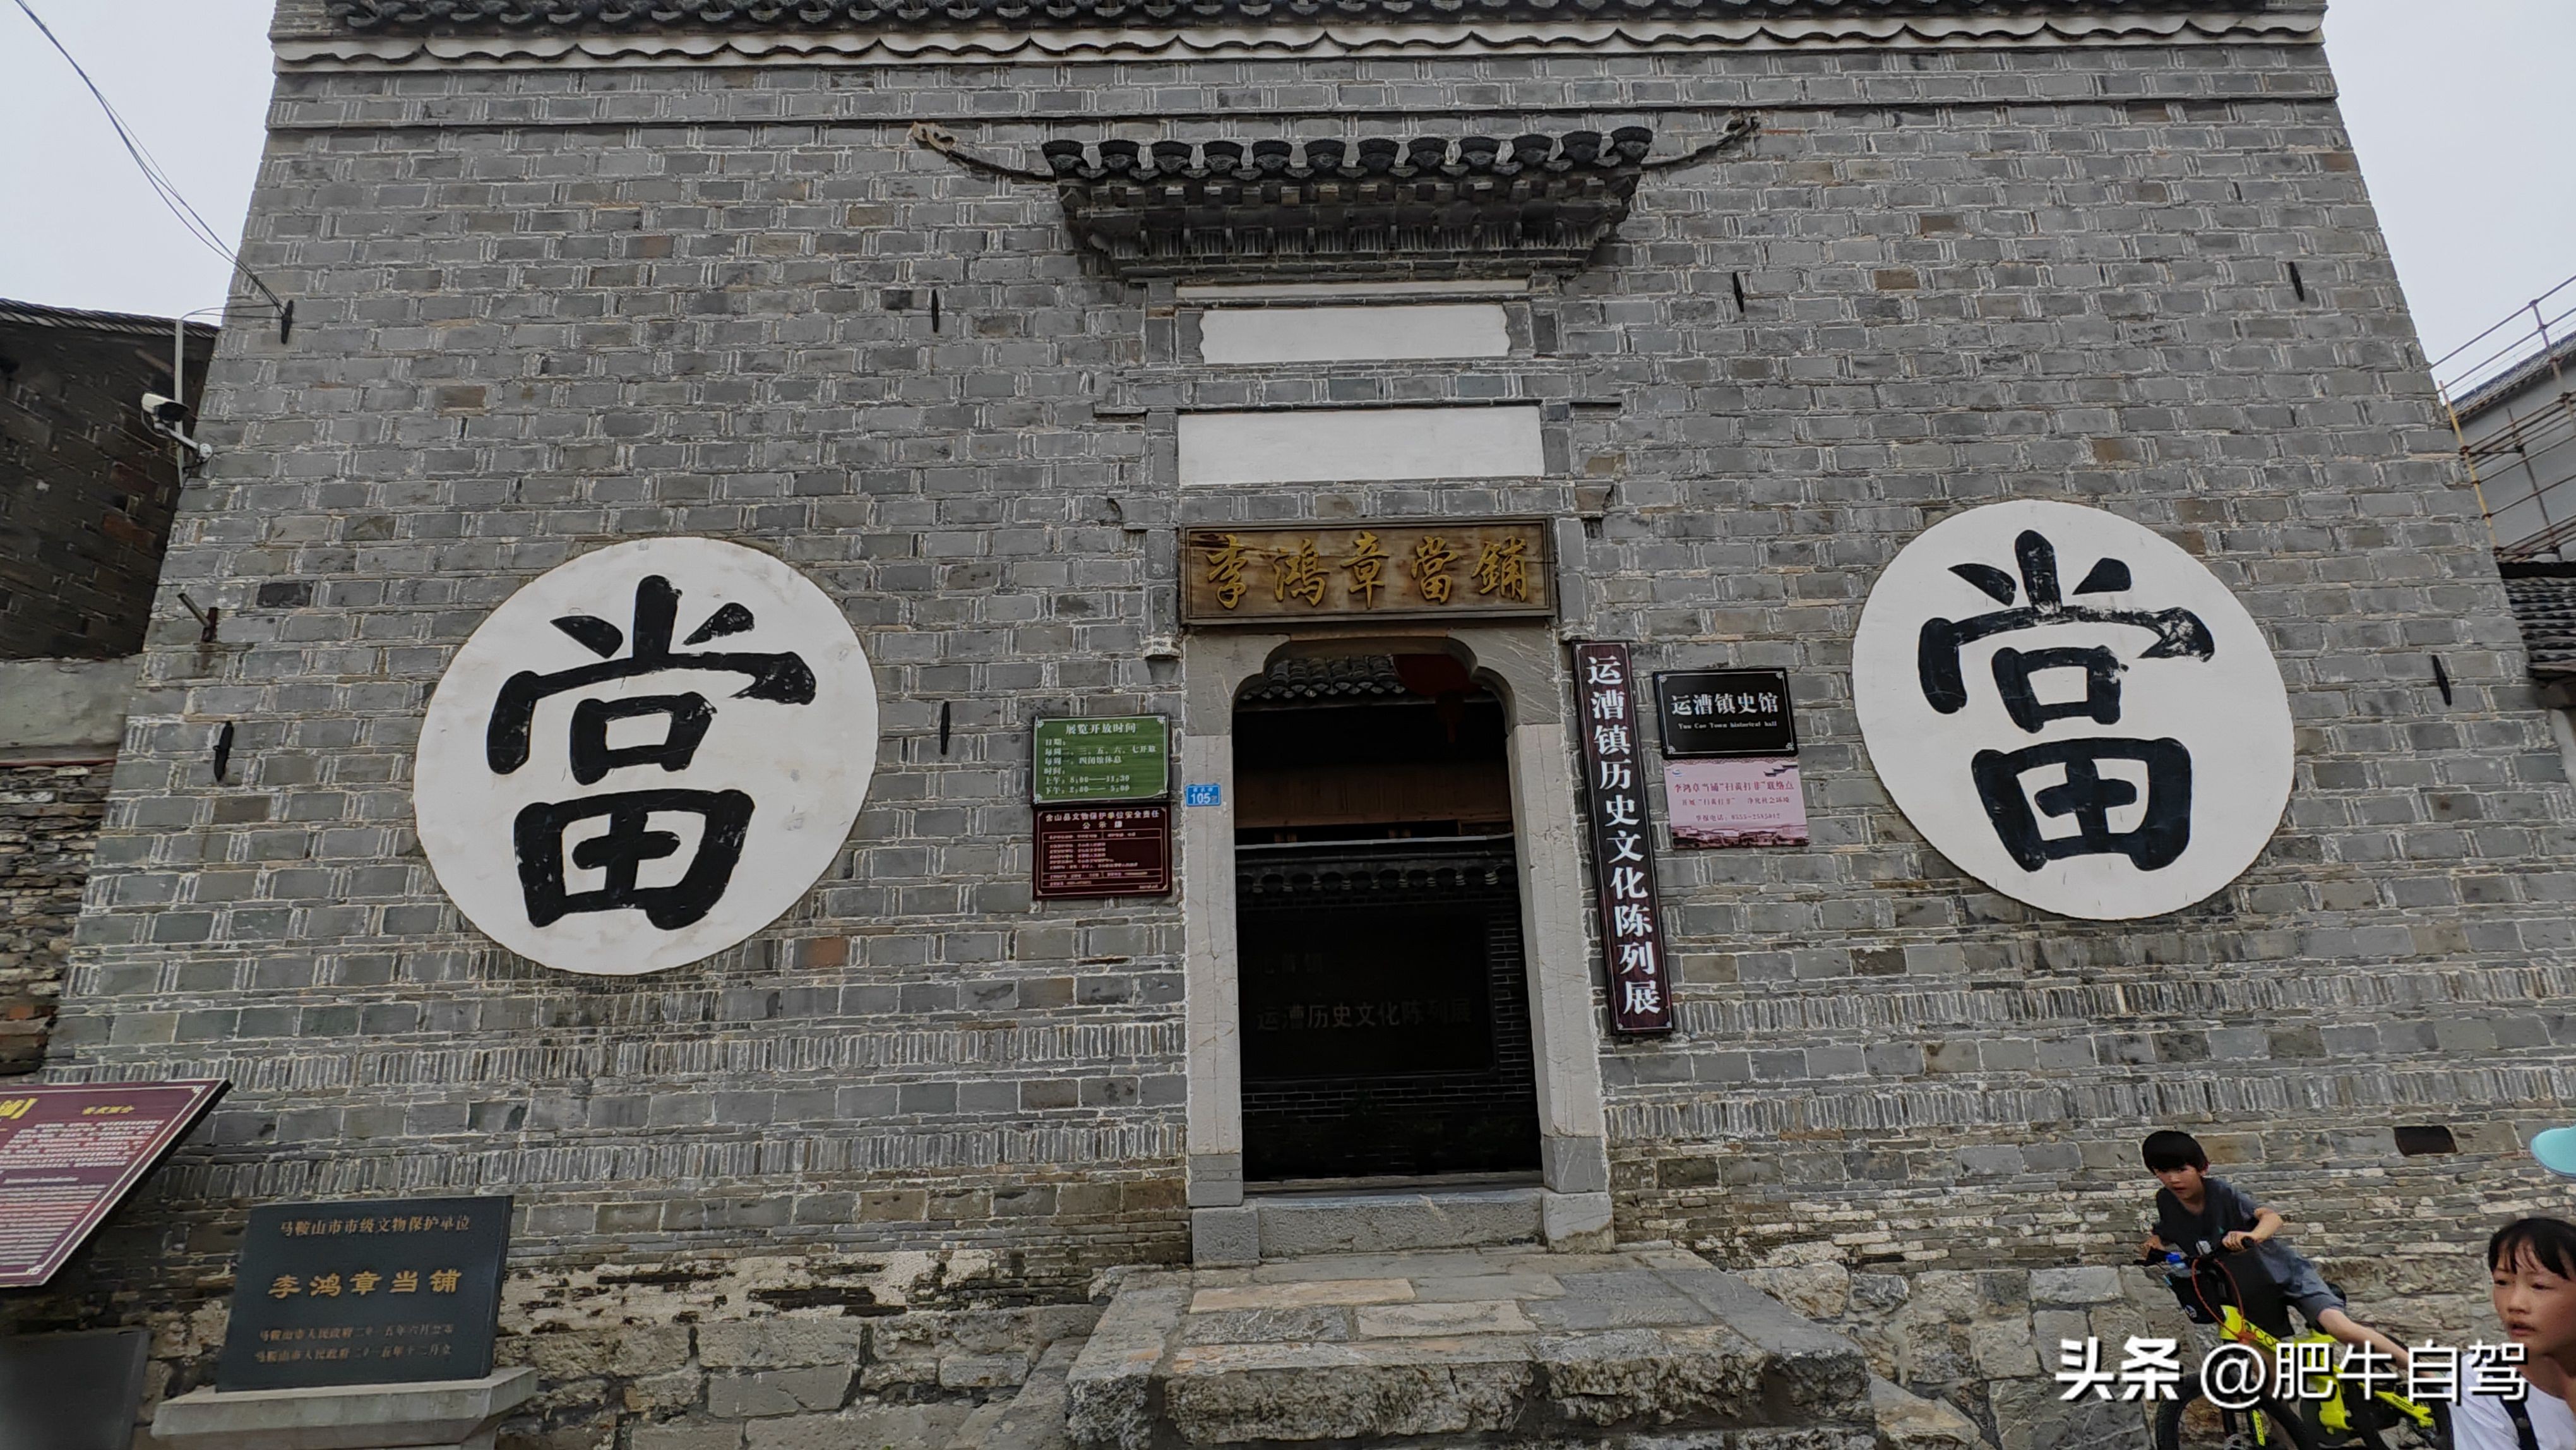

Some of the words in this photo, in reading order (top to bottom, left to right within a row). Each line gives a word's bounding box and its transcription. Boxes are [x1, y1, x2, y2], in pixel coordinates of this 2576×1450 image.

[1671, 692, 1779, 716] 运漕镇史馆
[1918, 529, 2215, 872] 當
[1065, 722, 1136, 735] 展览开放时间
[487, 575, 816, 930] 當
[1045, 810, 1160, 822] 含山县文物保护单位安全责任
[1587, 656, 1661, 1016] 运漕镇历史文化陈列展
[1257, 998, 1472, 1031] 运漕历史文化陈列展
[280, 1215, 470, 1238] 马鞍山市市级文物保护单位
[268, 1268, 462, 1298] 李鸿章当铺
